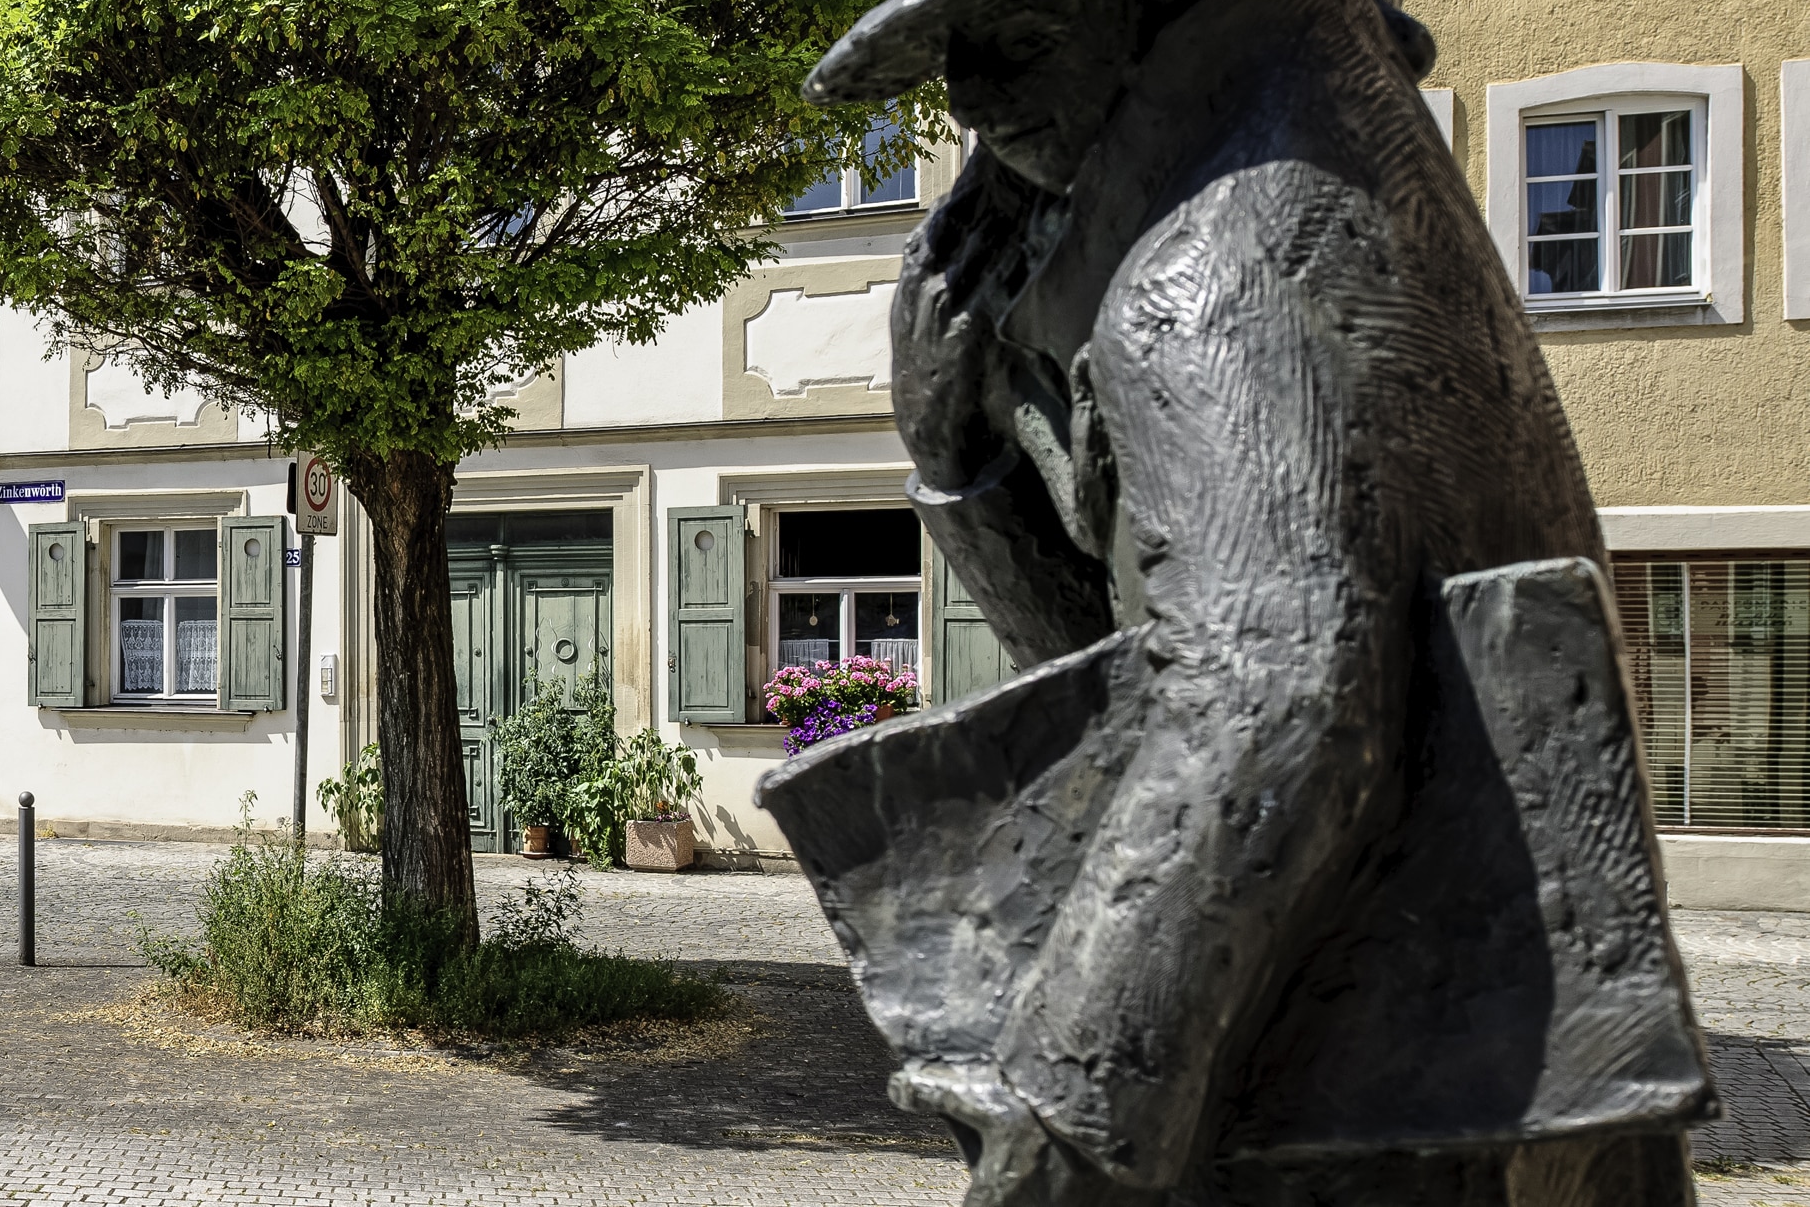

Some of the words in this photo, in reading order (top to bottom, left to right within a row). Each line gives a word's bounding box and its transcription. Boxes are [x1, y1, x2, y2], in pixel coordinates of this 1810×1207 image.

[309, 471, 327, 497] 30
[307, 514, 328, 530] ZONE
[285, 551, 300, 564] 25
